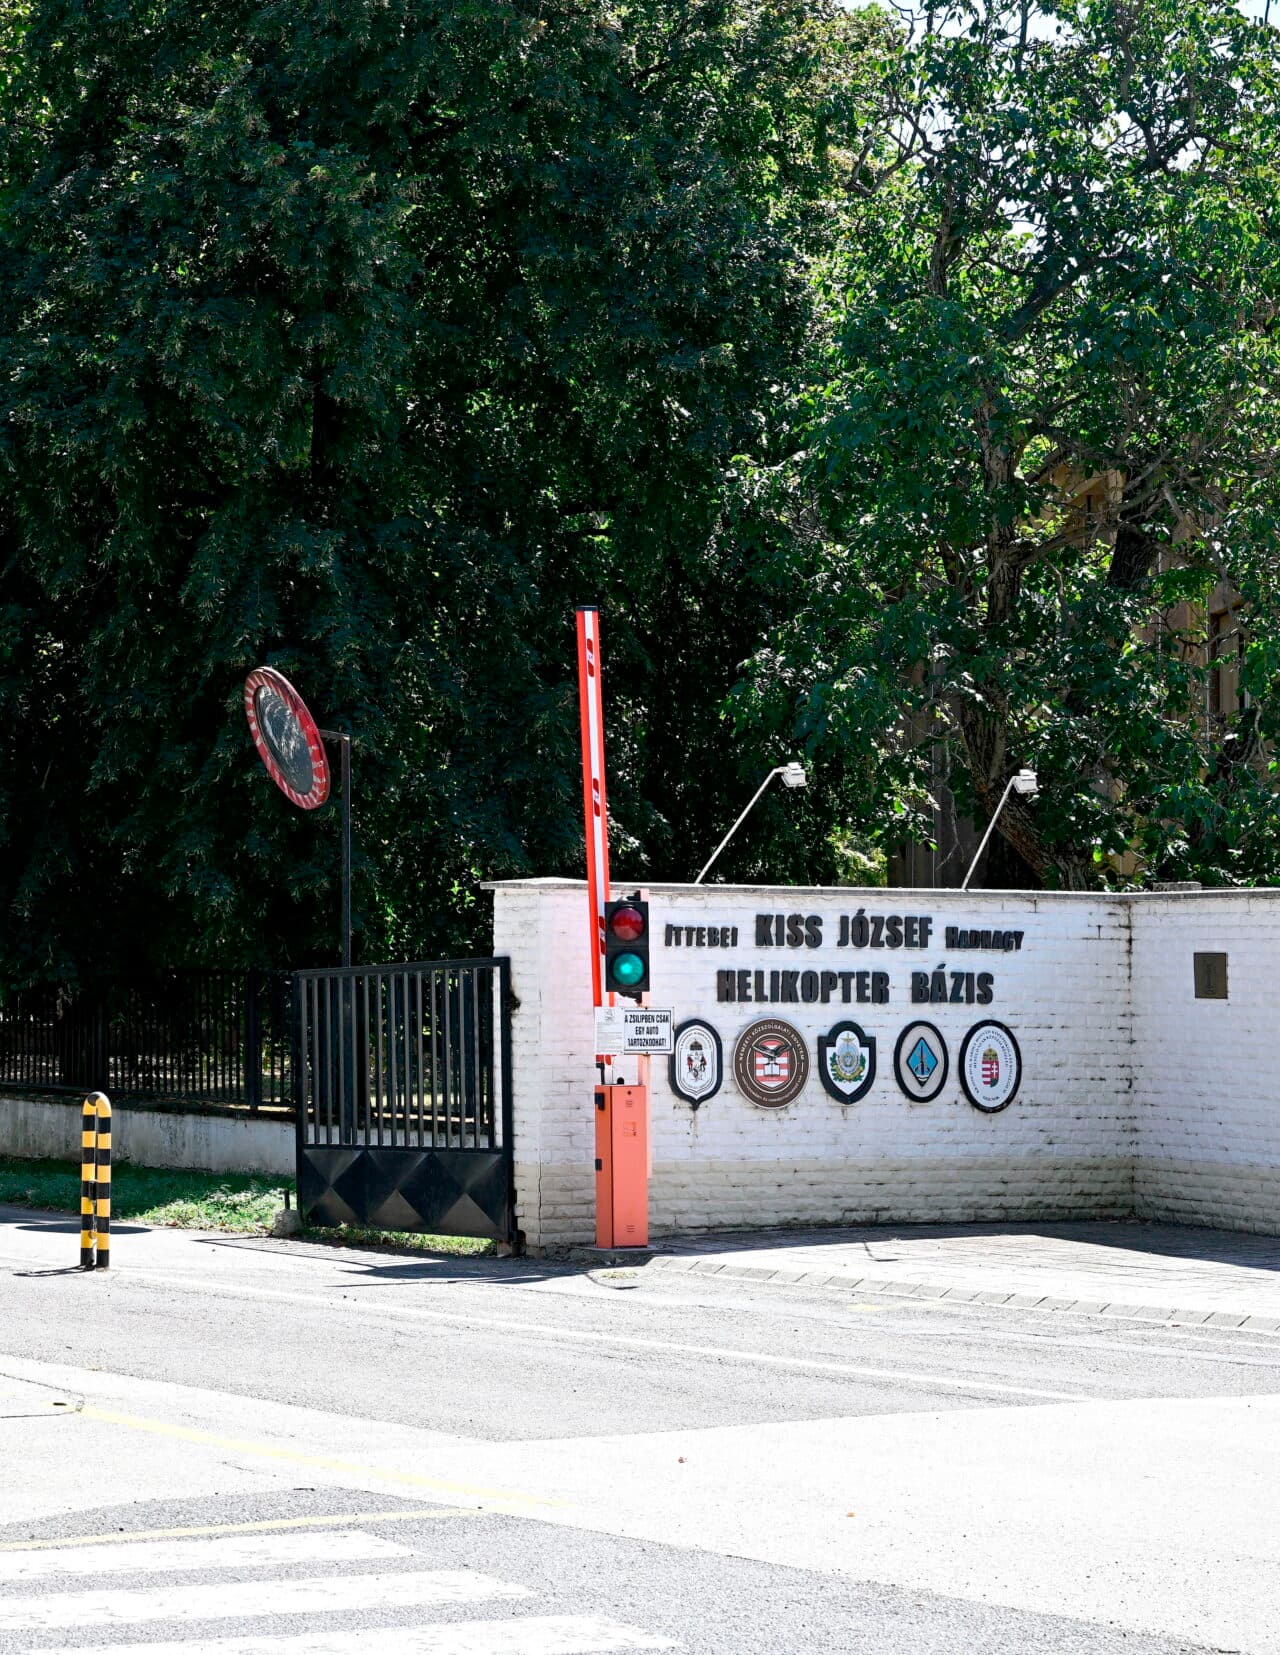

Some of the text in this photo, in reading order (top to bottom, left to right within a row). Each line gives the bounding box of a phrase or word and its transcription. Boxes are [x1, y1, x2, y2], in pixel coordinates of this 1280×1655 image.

[665, 908, 1024, 951] ITTEBEI KISS JÓZSEF HADNAGY
[716, 963, 994, 1004] HELIKOPTER BÁZIS
[624, 1014, 669, 1023] A ZSILIPBEN CSAK
[635, 1026, 645, 1035] EGY
